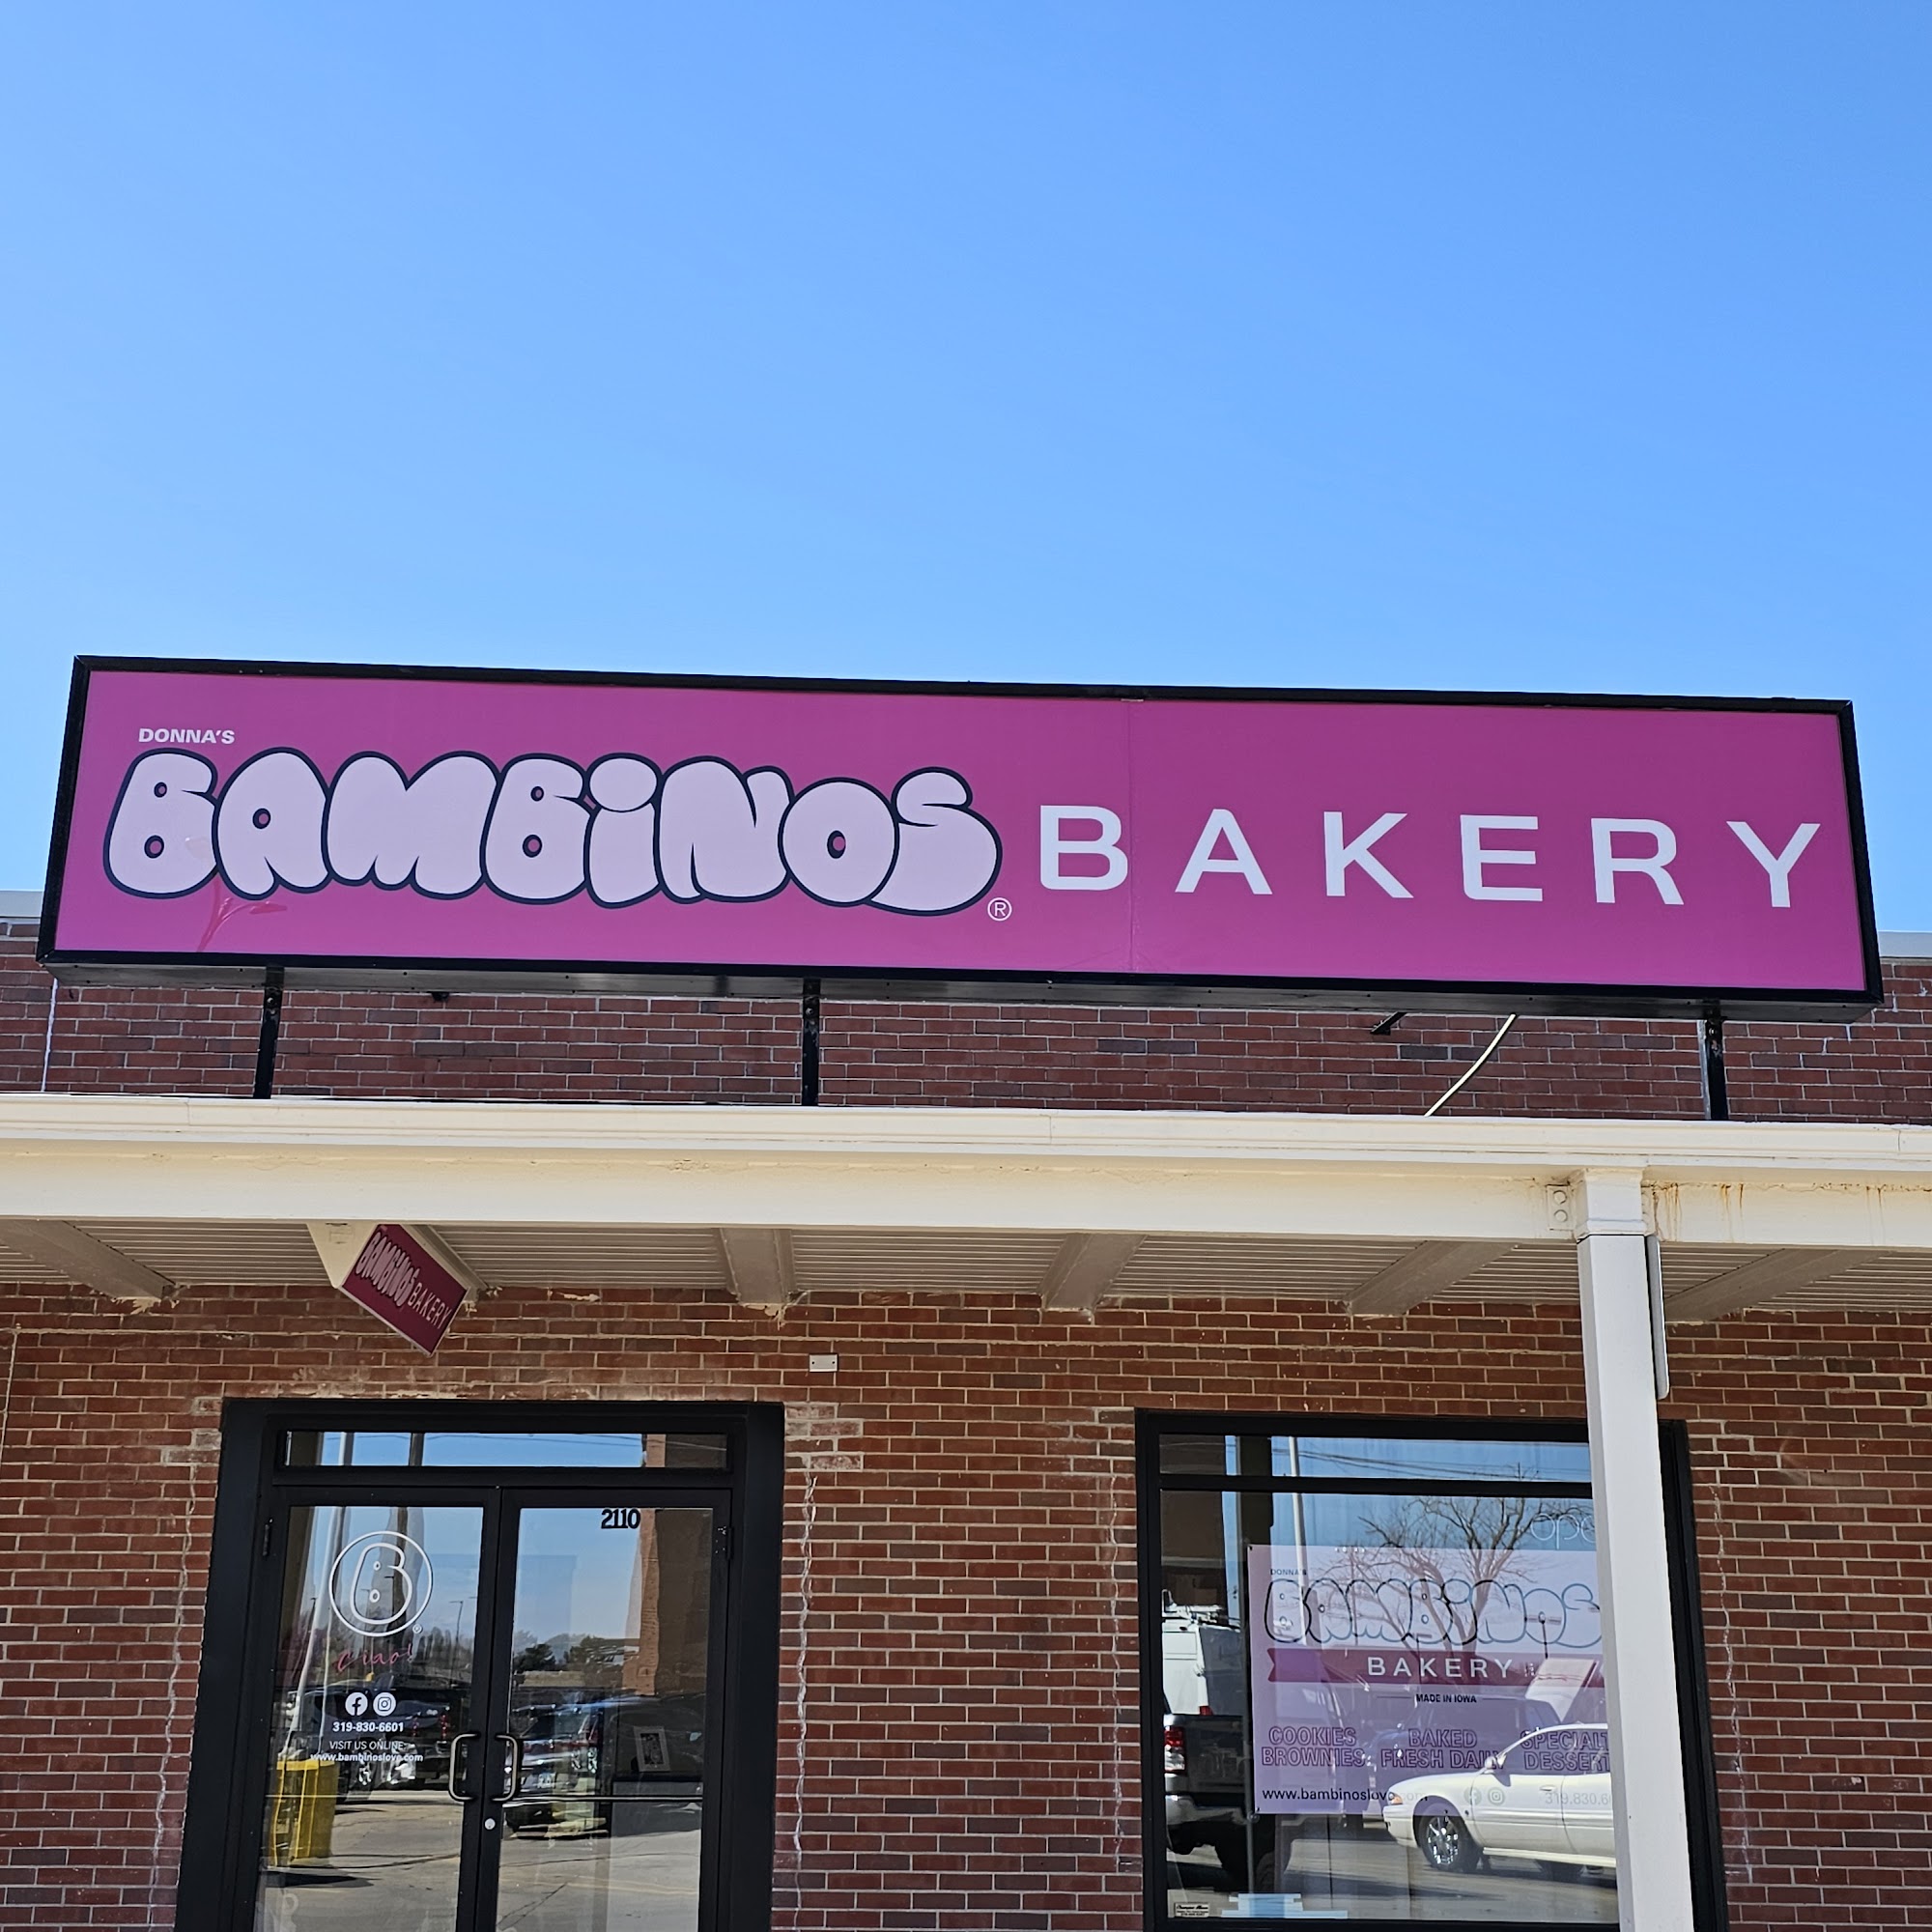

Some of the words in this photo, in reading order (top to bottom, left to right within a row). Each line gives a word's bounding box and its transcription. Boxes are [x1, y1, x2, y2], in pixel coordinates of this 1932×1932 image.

[138, 727, 235, 745] DONNA'S
[1039, 805, 1821, 909] BAKERY
[408, 1282, 452, 1329] BAKERY
[601, 1508, 641, 1529] 2110
[1530, 1513, 1597, 1549] ope
[1368, 1657, 1514, 1679] BAKERY
[1415, 1693, 1441, 1703] MADE
[1443, 1693, 1452, 1703] IN
[1454, 1694, 1478, 1703] IOWA
[332, 1721, 404, 1732] 319-830-6601
[1268, 1726, 1357, 1746] COOKIES
[329, 1741, 352, 1750] VISIT
[355, 1741, 367, 1750] US
[1408, 1728, 1478, 1748] BAKED
[1520, 1729, 1609, 1750] SPECIALT
[1261, 1747, 1366, 1768] BROWNIES
[1381, 1748, 1444, 1769] FRESH
[1523, 1751, 1610, 1772] DESSERT
